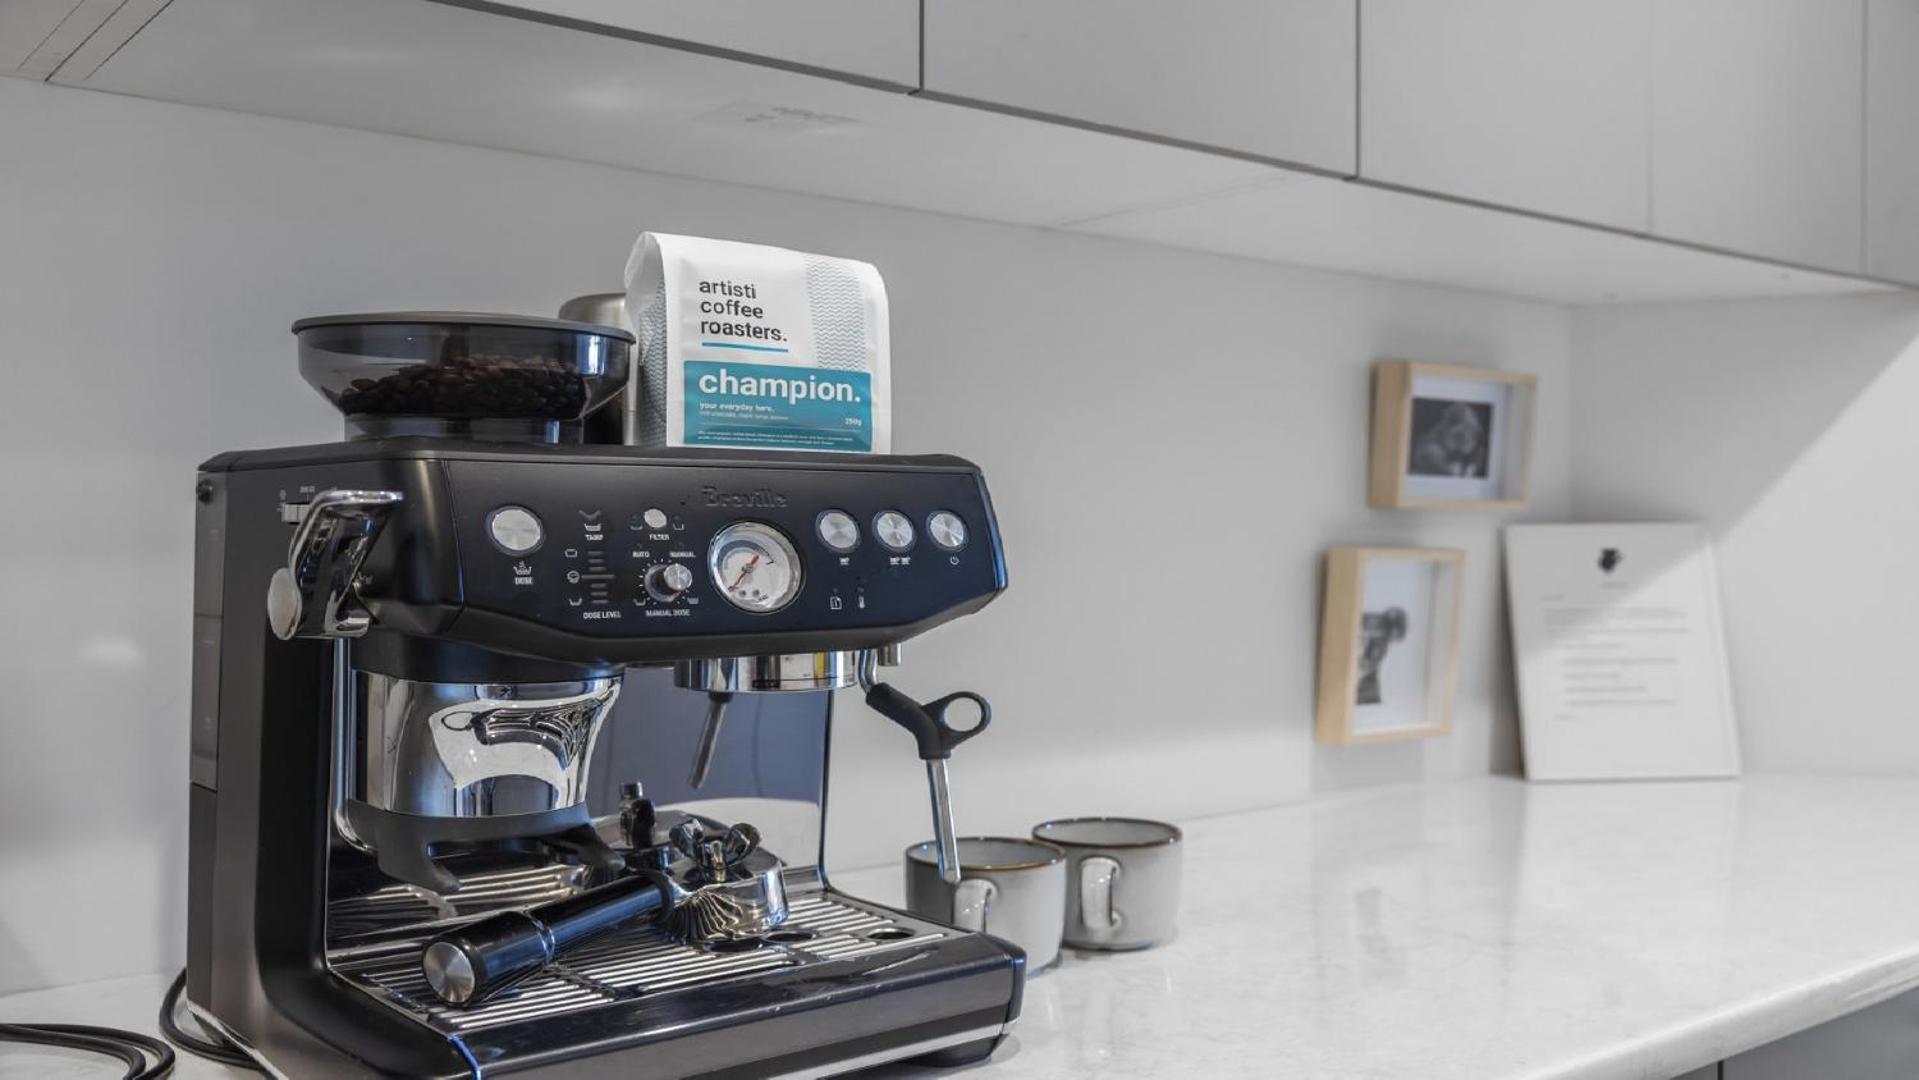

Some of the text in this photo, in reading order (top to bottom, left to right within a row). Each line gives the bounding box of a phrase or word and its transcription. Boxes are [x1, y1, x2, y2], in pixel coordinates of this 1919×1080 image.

[699, 280, 757, 299] artisti
[701, 300, 764, 319] coffee
[701, 320, 788, 342] roasters.
[699, 368, 861, 405] champion.
[702, 485, 788, 508] Breville
[601, 611, 621, 619] LEVEL
[646, 609, 673, 617] MANUAL
